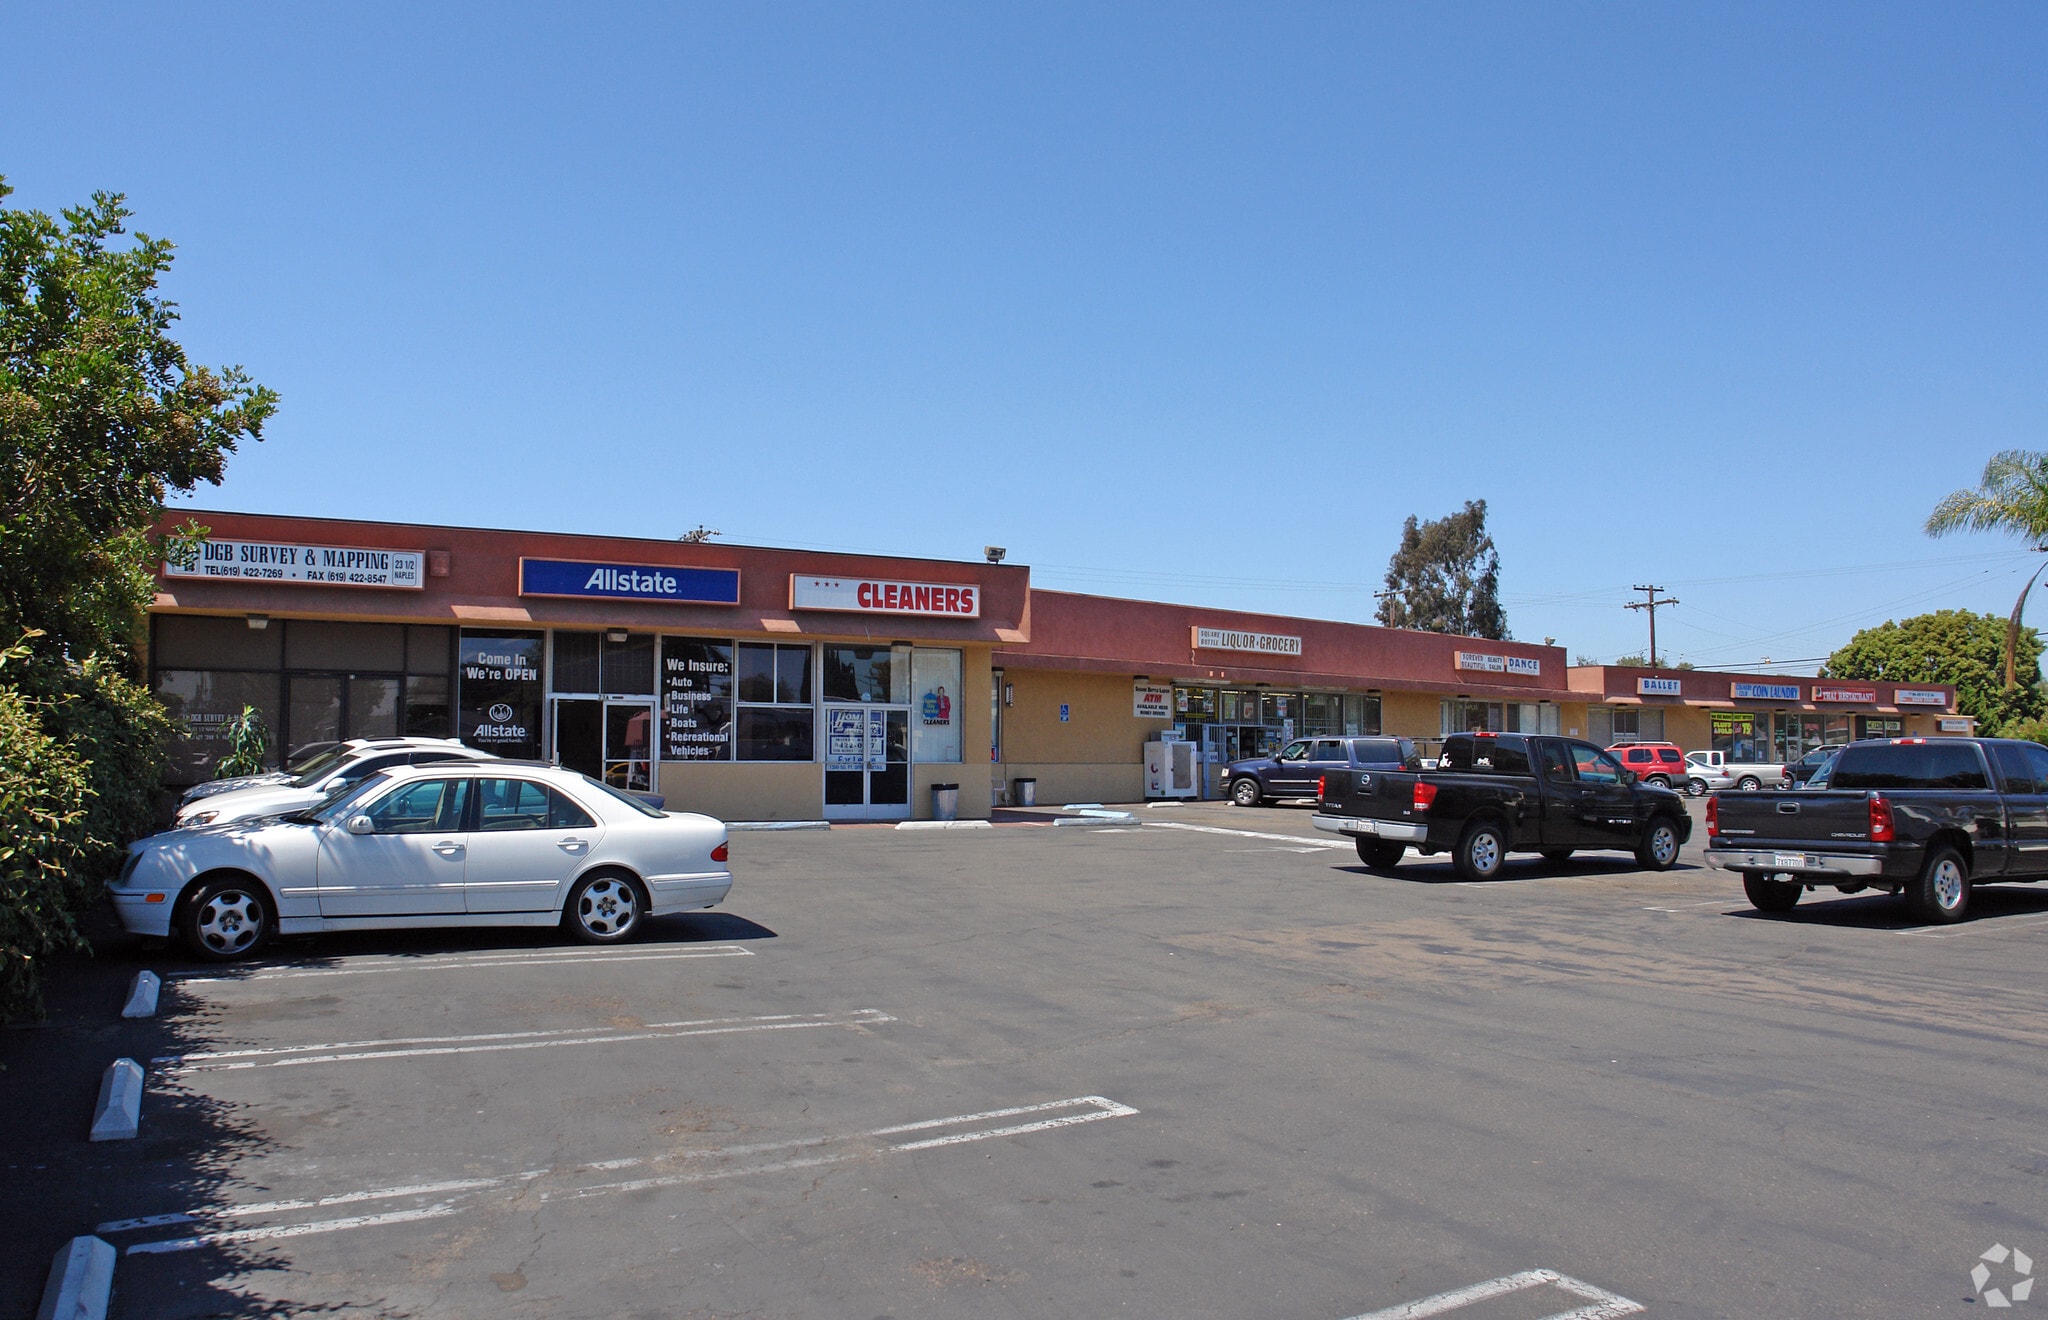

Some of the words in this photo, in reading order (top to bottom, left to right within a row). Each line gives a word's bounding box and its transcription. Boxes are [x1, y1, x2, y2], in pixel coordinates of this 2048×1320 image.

[204, 542, 234, 561] DGB
[240, 545, 298, 565] SURVEY
[304, 548, 316, 566] &
[323, 549, 389, 570] MAPPING
[394, 559, 404, 570] 23
[405, 560, 415, 570] 1/2
[204, 565, 241, 577] TEL(619)
[243, 567, 283, 578] 422-7269
[307, 570, 325, 580] FAX
[327, 571, 347, 583] (619)
[348, 573, 388, 584] 422-8547
[394, 571, 415, 580] NAPLES
[584, 568, 677, 594] Allstate
[857, 582, 974, 614] CLEANERS
[1200, 630, 1220, 638] SQUARE
[1201, 638, 1219, 647] BOTTLE
[1221, 632, 1256, 649] LIQUOR
[1259, 635, 1300, 653] GROCERY
[478, 652, 511, 666] Come
[515, 654, 527, 666] In
[1462, 653, 1484, 663] FOREVER
[666, 659, 685, 671] We
[688, 660, 729, 673] Insure:
[1461, 661, 1486, 671] BEAUTIFUL
[1509, 658, 1538, 670] DANCE
[466, 667, 502, 680] We're
[504, 668, 537, 681] OPEN
[671, 677, 693, 687] Auto
[1644, 680, 1678, 690] BALLET
[671, 690, 712, 701] Business
[1752, 685, 1768, 697] COIN
[1770, 686, 1798, 699] LAUNDRY
[1144, 693, 1162, 703] ATM
[671, 704, 689, 714] Life
[671, 718, 697, 728] Boats
[473, 725, 526, 737] Allstate
[671, 732, 729, 742] Recreational
